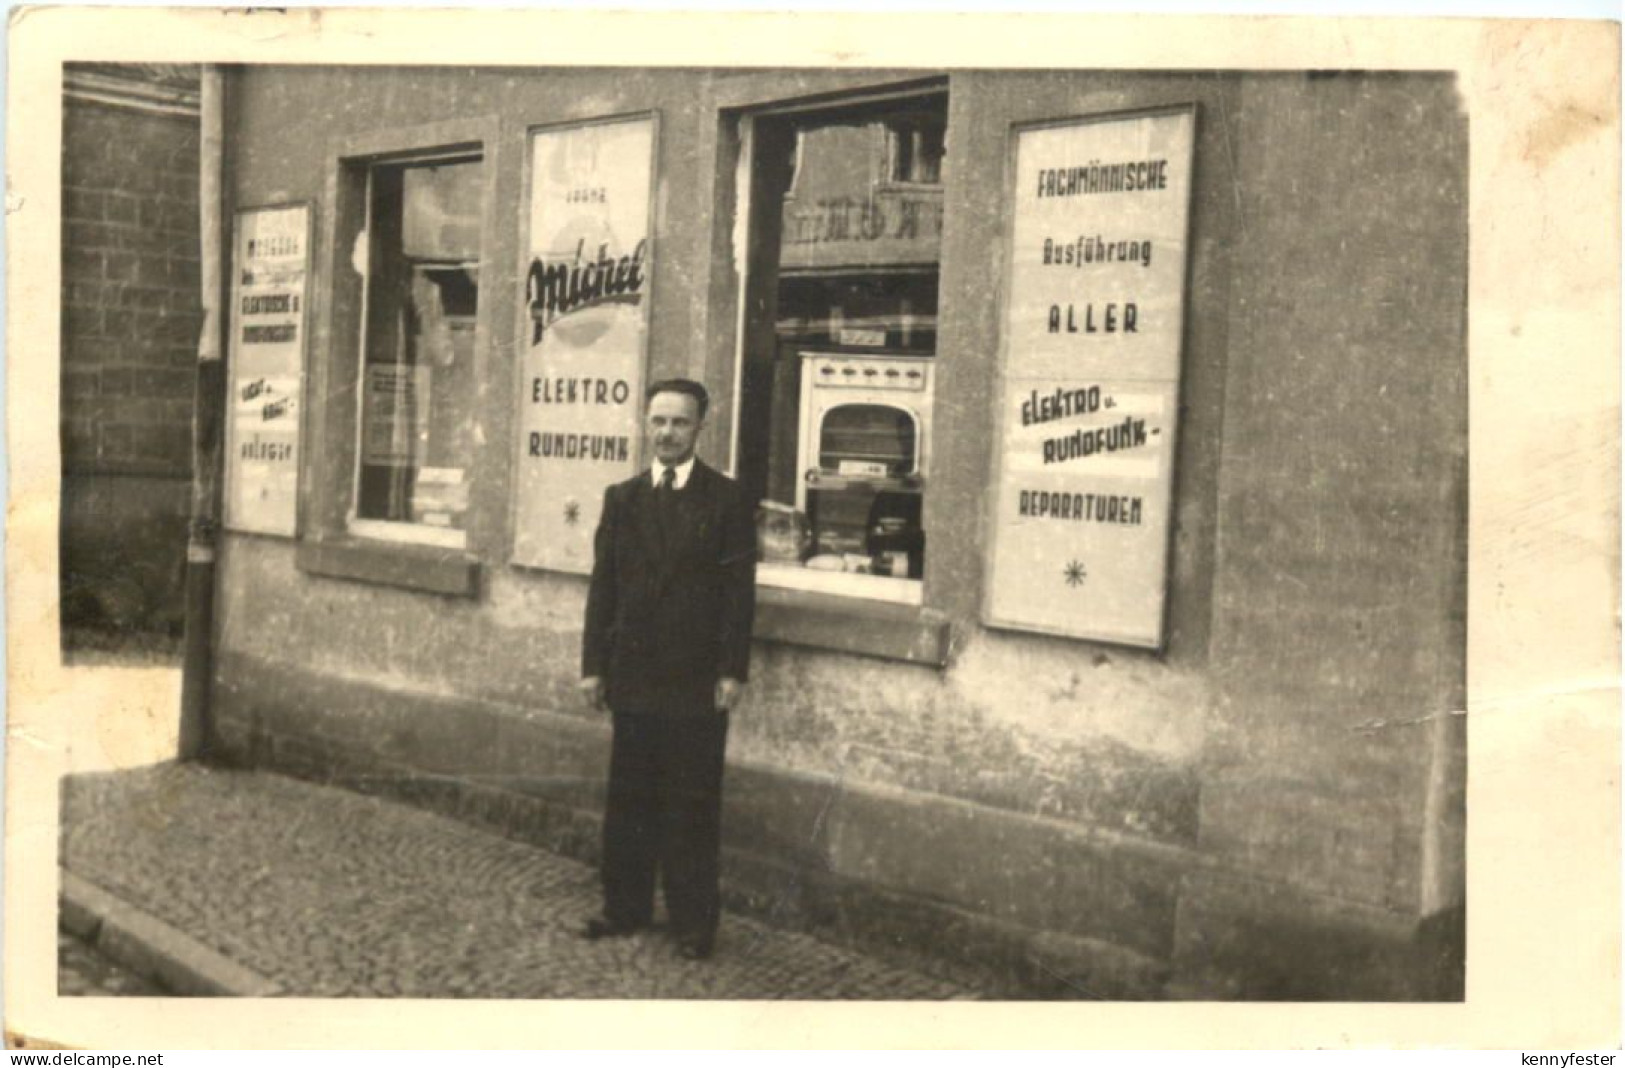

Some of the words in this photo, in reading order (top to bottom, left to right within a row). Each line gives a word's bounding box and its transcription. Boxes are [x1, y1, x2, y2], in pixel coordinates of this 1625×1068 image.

[1037, 159, 1168, 198] FACHMÄNNISCHE
[1043, 234, 1153, 268] Ausführung
[526, 238, 647, 346] Michel
[1047, 302, 1139, 334] ALLER
[532, 376, 630, 404] ELEKTRO
[1021, 384, 1101, 428] ELEKTRO
[528, 431, 630, 462] RUNDFUNK
[1018, 489, 1143, 525] REPARATUREN
